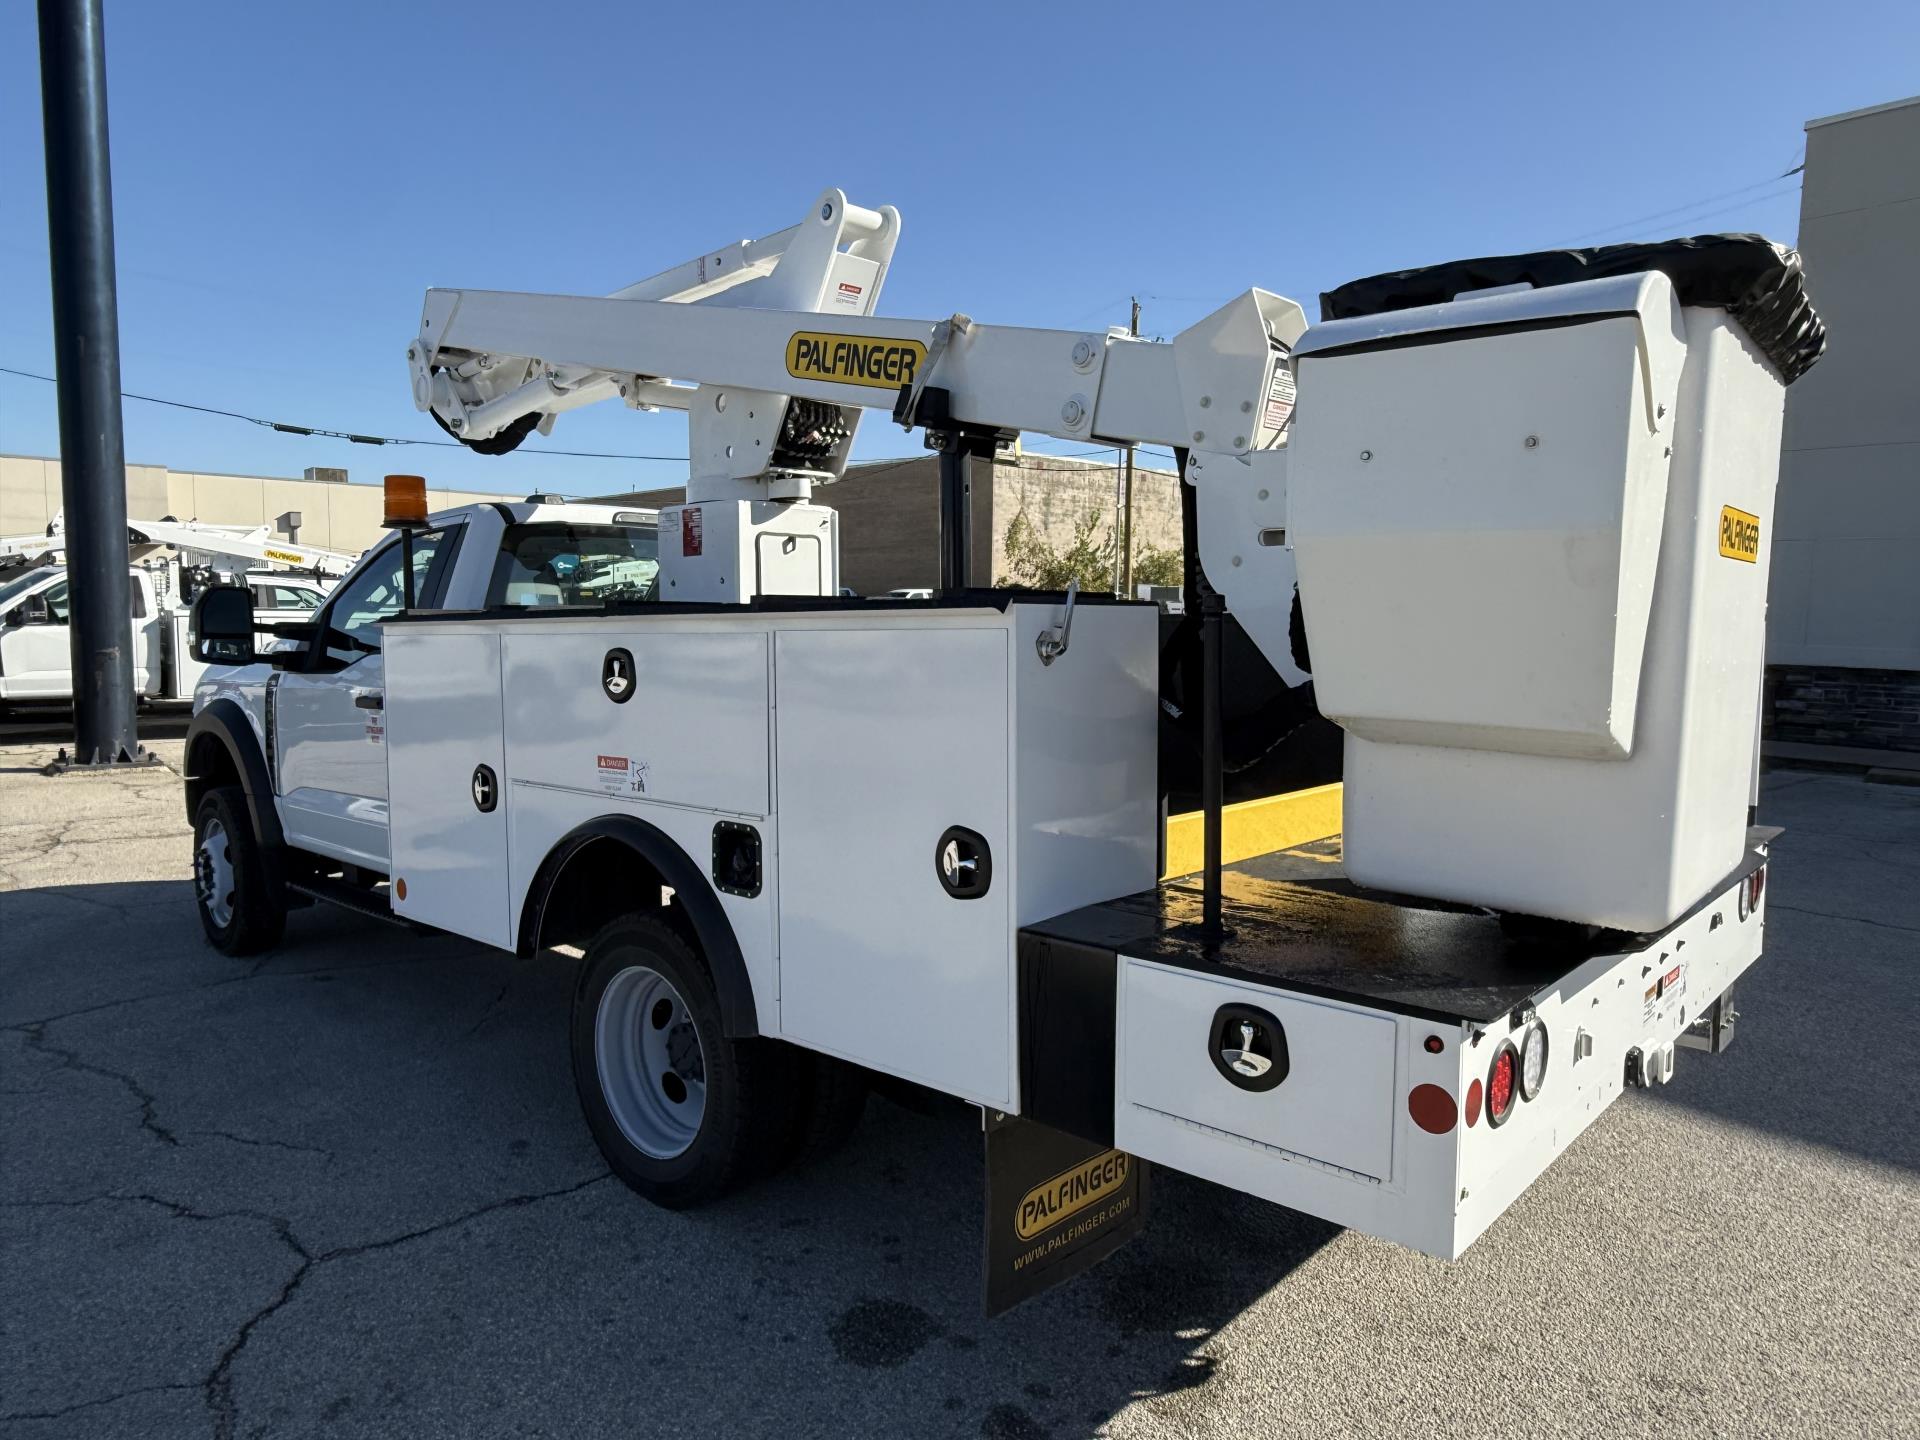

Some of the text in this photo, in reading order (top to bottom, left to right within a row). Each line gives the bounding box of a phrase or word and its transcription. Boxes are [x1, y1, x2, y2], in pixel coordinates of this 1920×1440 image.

[795, 339, 917, 383] PALFINGER
[1721, 514, 1759, 555] PALFINGER
[1021, 1152, 1126, 1230] PALFINGER
[1013, 1196, 1131, 1271] WWW.PALFINGER.COM
